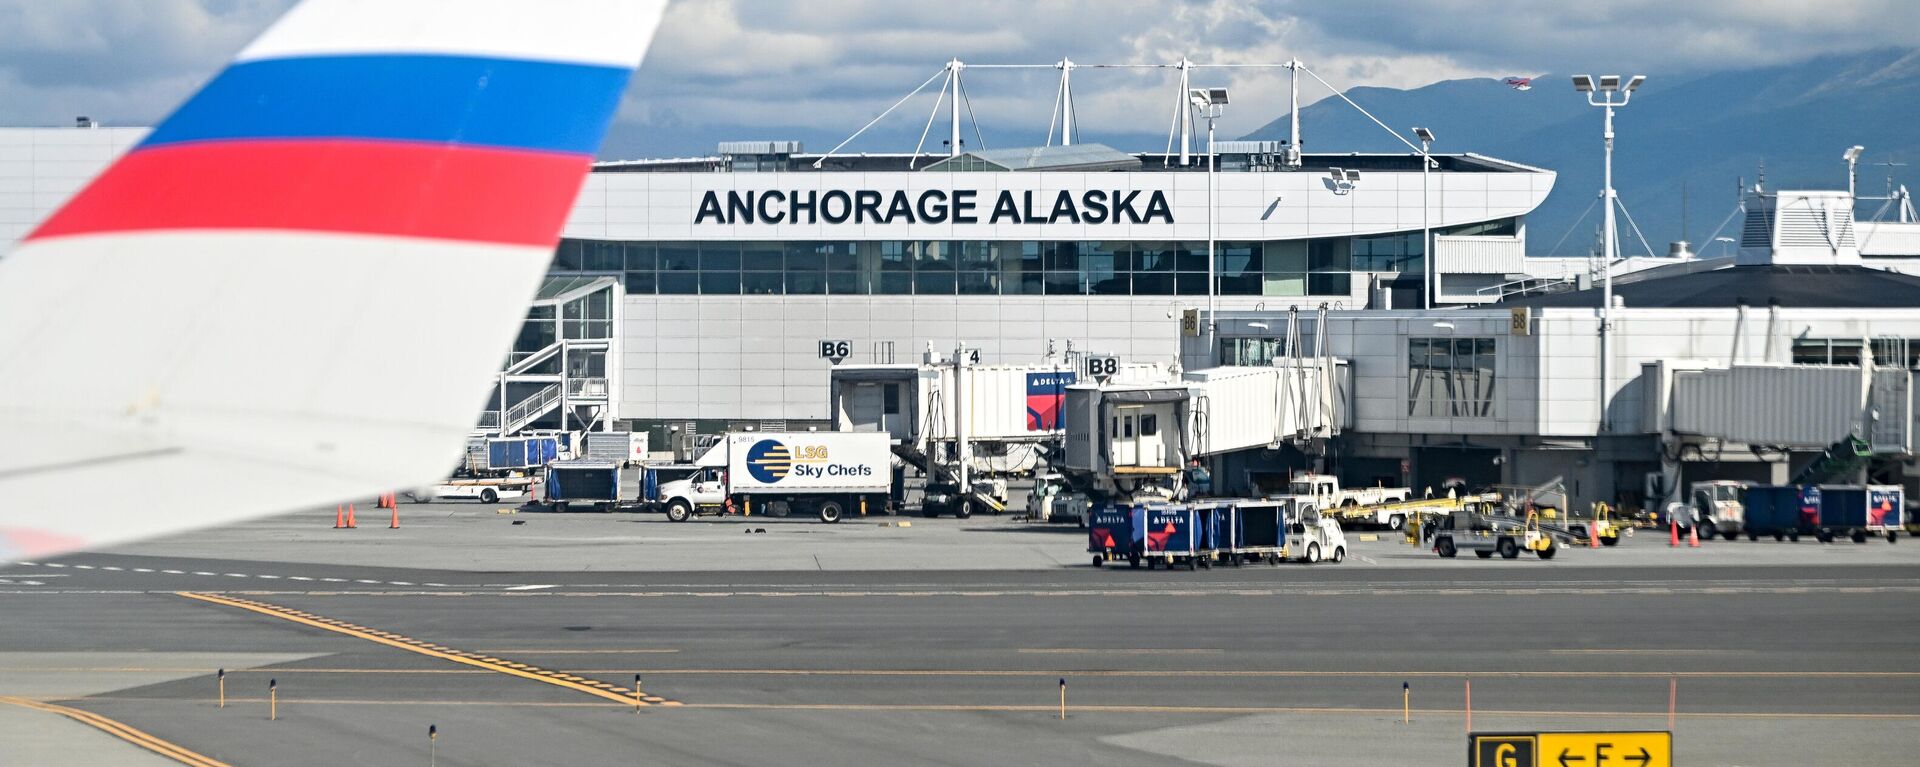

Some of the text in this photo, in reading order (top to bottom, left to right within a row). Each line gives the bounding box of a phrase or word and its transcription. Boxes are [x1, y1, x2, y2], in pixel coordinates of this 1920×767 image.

[694, 190, 1175, 225] ANCHORAGE ALASKA
[1185, 315, 1195, 330] B6
[1513, 313, 1526, 329] B8
[822, 341, 849, 357] B6
[1089, 358, 1117, 375] B8
[1040, 377, 1065, 385] DELTA
[795, 445, 829, 459] LSG
[795, 463, 872, 479] Sky Chefs
[1494, 742, 1518, 767] G
